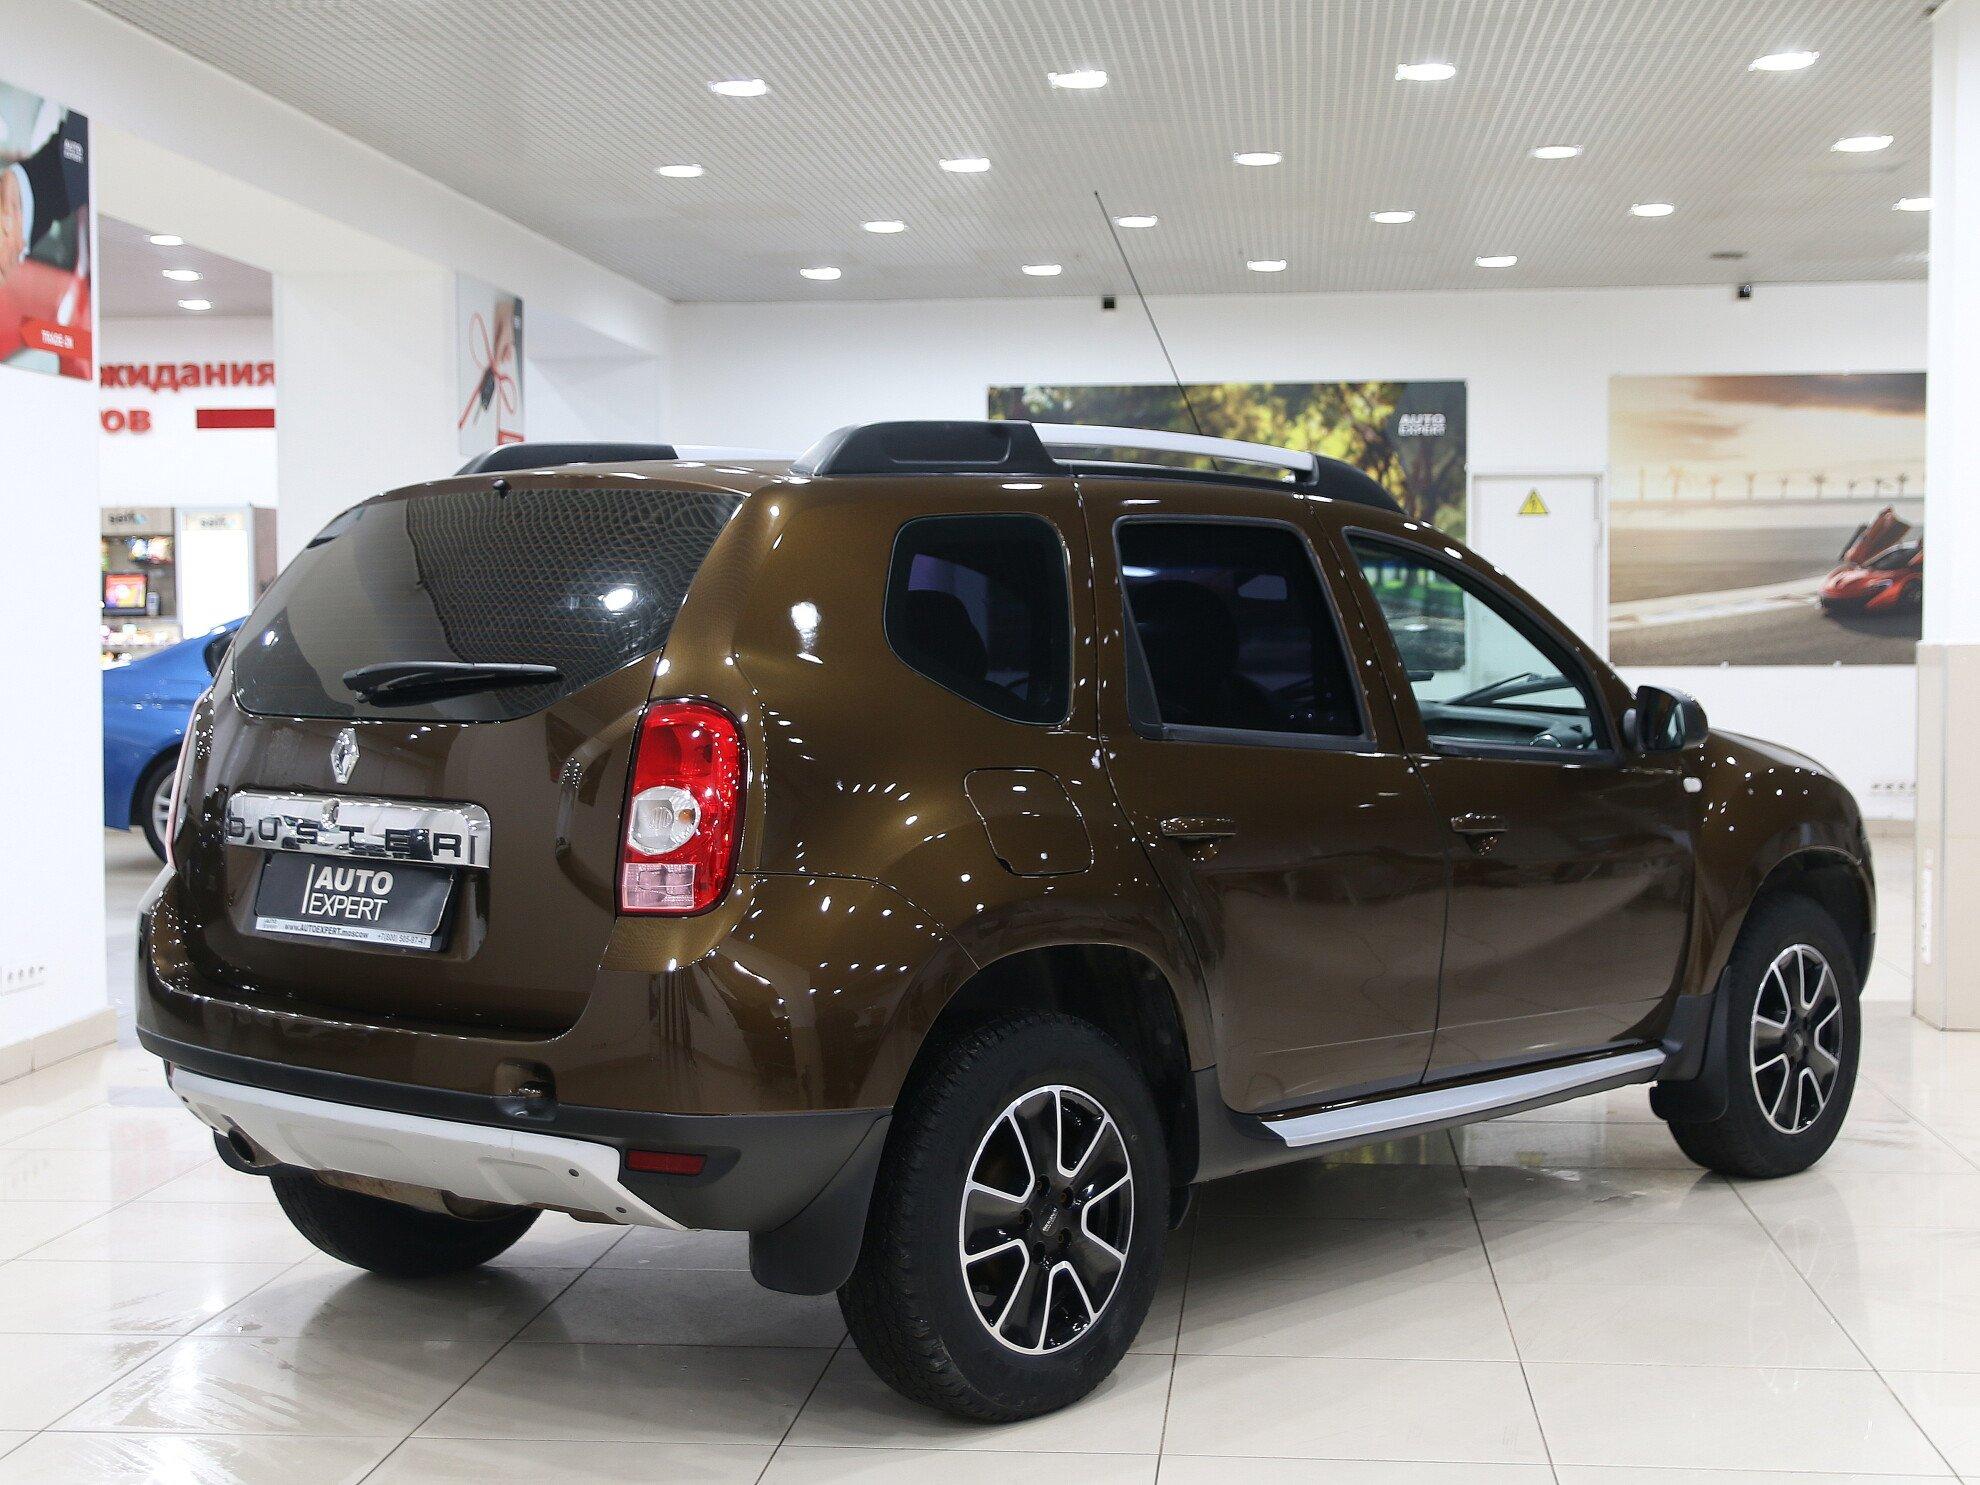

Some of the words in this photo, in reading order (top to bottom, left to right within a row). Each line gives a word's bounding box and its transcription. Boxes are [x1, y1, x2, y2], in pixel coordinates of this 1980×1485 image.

[1400, 413, 1446, 424] AUTO
[229, 816, 463, 858] DUSTER
[314, 866, 394, 896] AUTO
[308, 892, 389, 922] EXPERT
